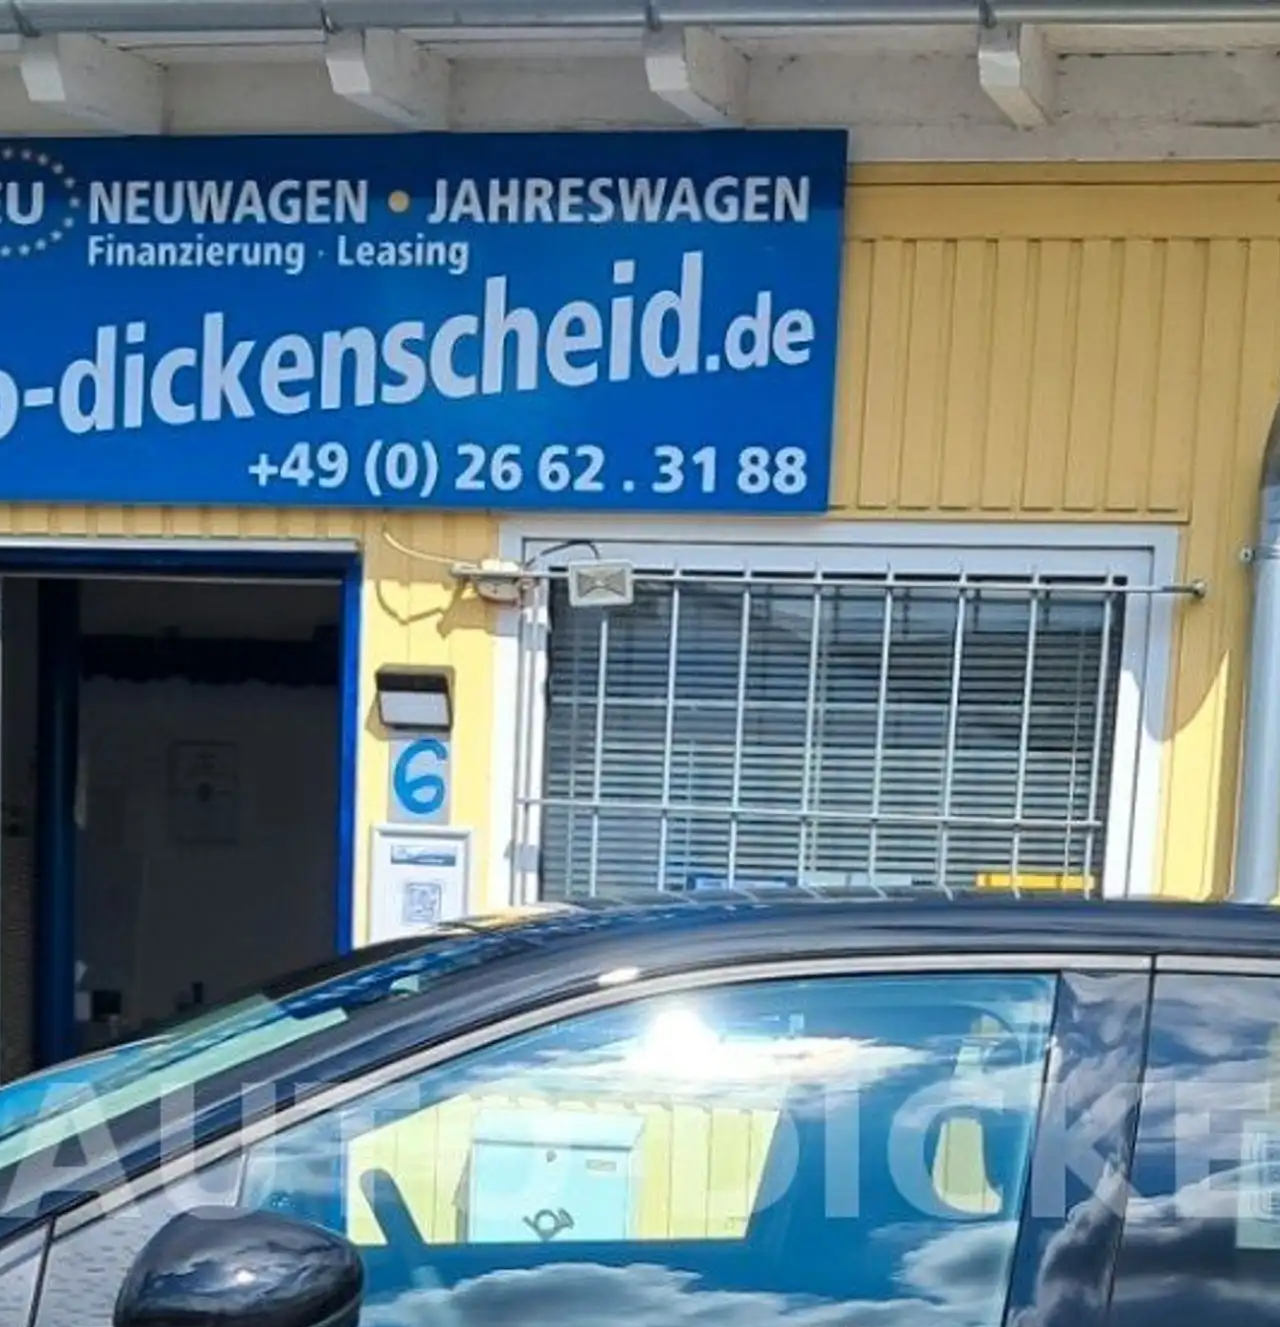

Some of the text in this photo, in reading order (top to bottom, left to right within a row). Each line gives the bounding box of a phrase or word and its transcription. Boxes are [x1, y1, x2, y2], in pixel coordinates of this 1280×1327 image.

[87, 180, 369, 225] NEUWAGEN
[426, 175, 810, 224] JAHRESWAGEN
[87, 232, 470, 275] Finanzierung Leasing
[247, 441, 349, 489] +49
[364, 439, 439, 498] (0)
[392, 737, 448, 816] 6
